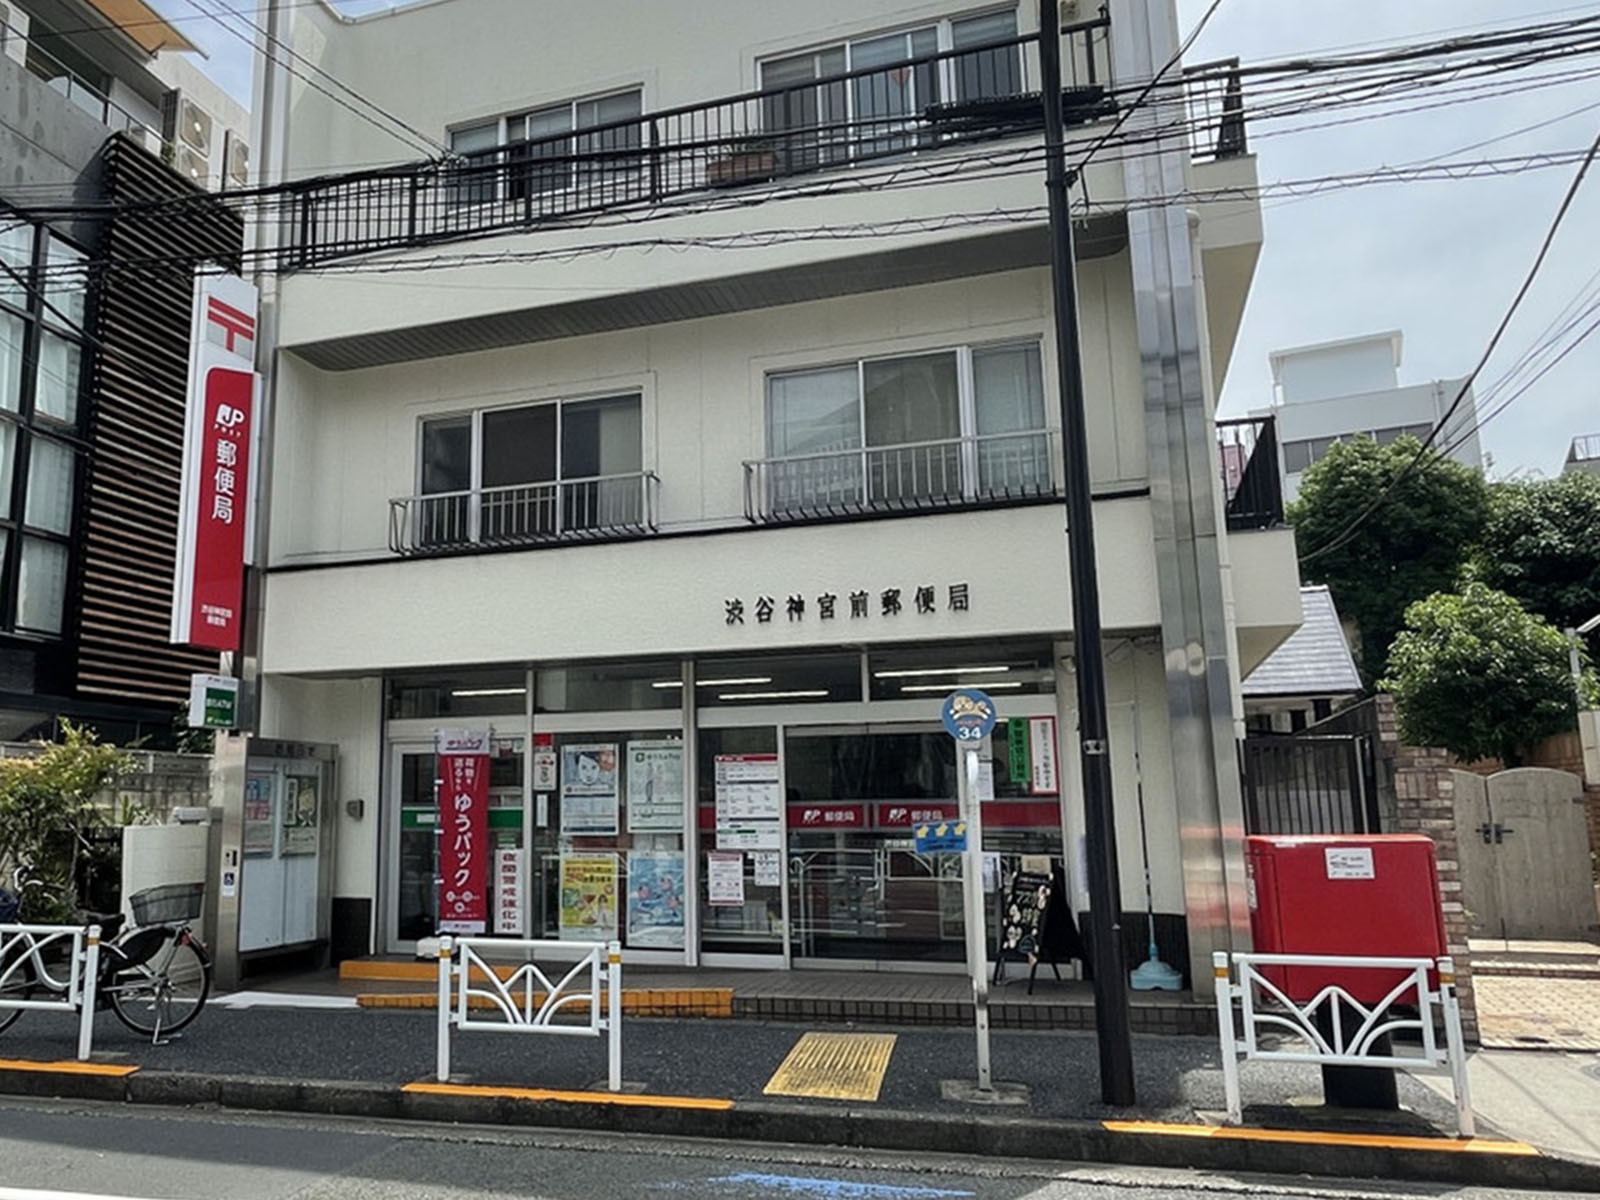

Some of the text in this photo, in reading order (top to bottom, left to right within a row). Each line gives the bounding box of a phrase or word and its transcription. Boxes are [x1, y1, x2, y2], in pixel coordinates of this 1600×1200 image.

[212, 438, 238, 524] 郵便局
[724, 582, 970, 625] 渋谷神宮前郵便局
[959, 726, 981, 740] 34
[454, 793, 472, 887] ゆうパック
